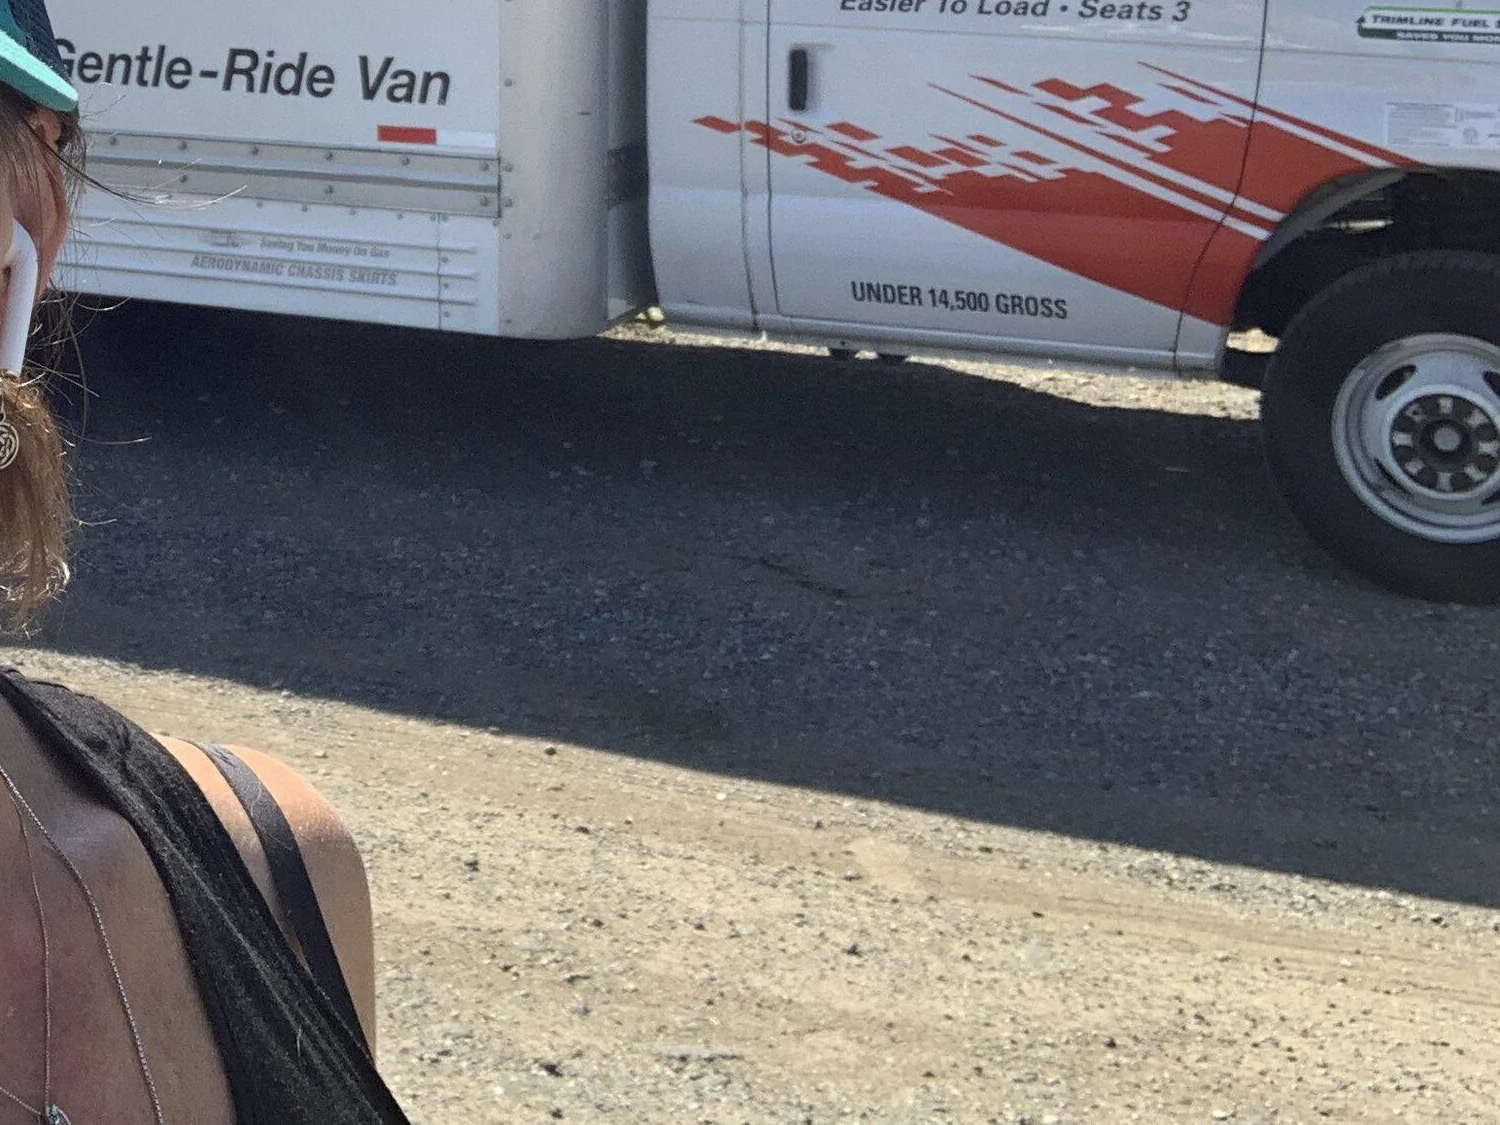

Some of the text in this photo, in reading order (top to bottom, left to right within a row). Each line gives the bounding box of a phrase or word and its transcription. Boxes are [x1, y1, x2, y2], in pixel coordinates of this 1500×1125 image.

[1171, 0, 1192, 23] 3
[358, 54, 451, 106] Van
[191, 254, 399, 287] AERODYNAMIC CHASSIS SKIRTS
[851, 280, 1069, 320] UNDER 14,500 GROSS
